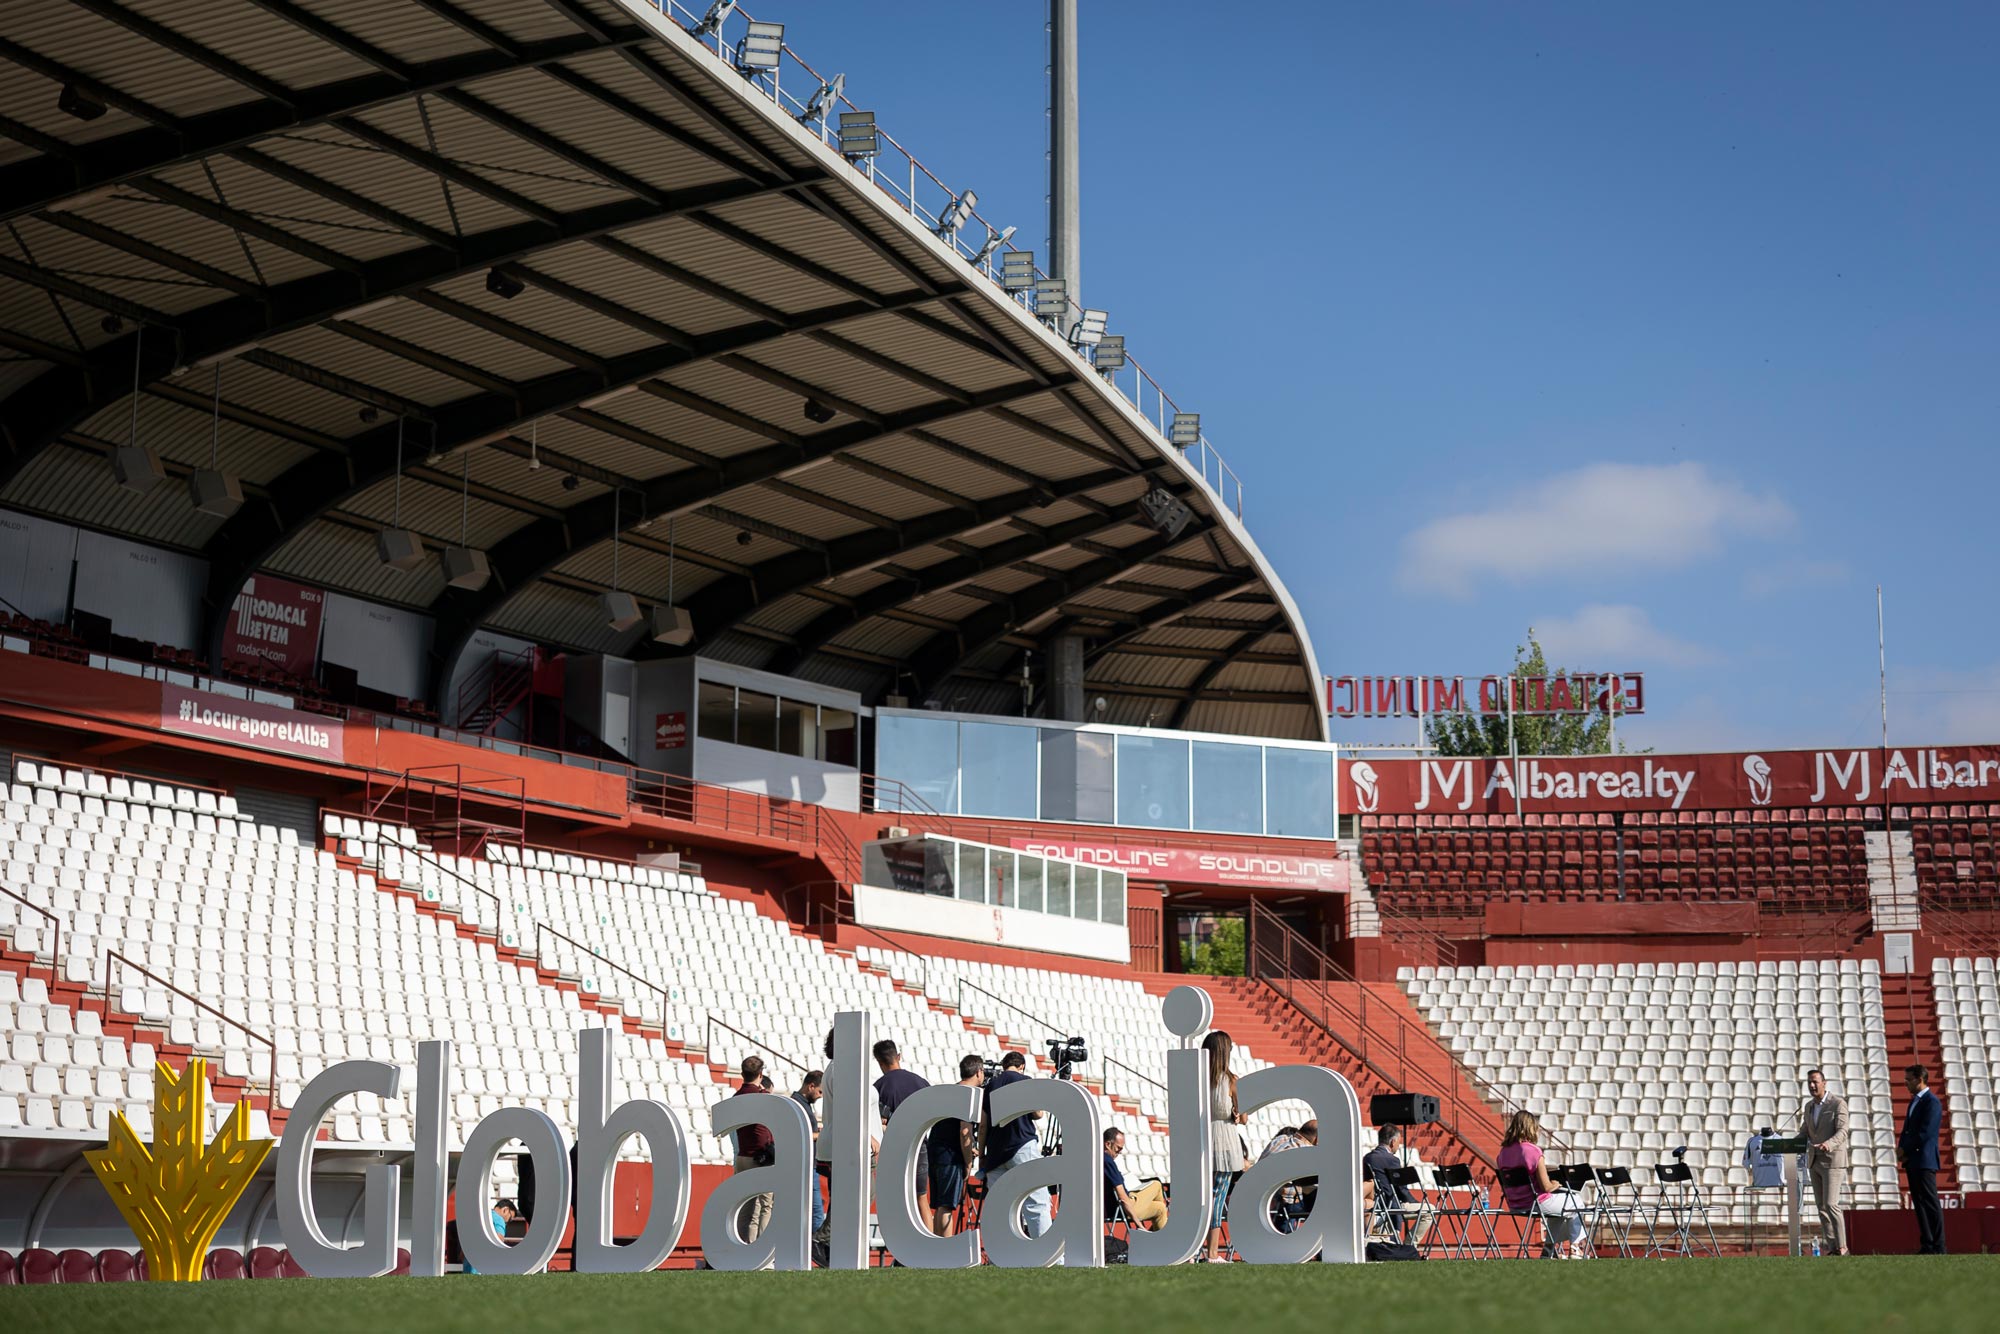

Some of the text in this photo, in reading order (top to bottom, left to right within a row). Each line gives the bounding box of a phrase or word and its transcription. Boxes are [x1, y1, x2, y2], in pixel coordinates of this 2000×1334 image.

[300, 591, 316, 602] BOX
[252, 598, 307, 627] RODACAL
[237, 643, 287, 662] rodacal.com
[179, 699, 329, 749] #LocuraporelAlba
[1482, 759, 1696, 809] Albarealty
[1880, 749, 2000, 790] Albar
[1026, 844, 1169, 867] SOUNDLINE
[1199, 855, 1336, 878] SOUNDLINE
[276, 985, 1367, 1277] Globalcaja
